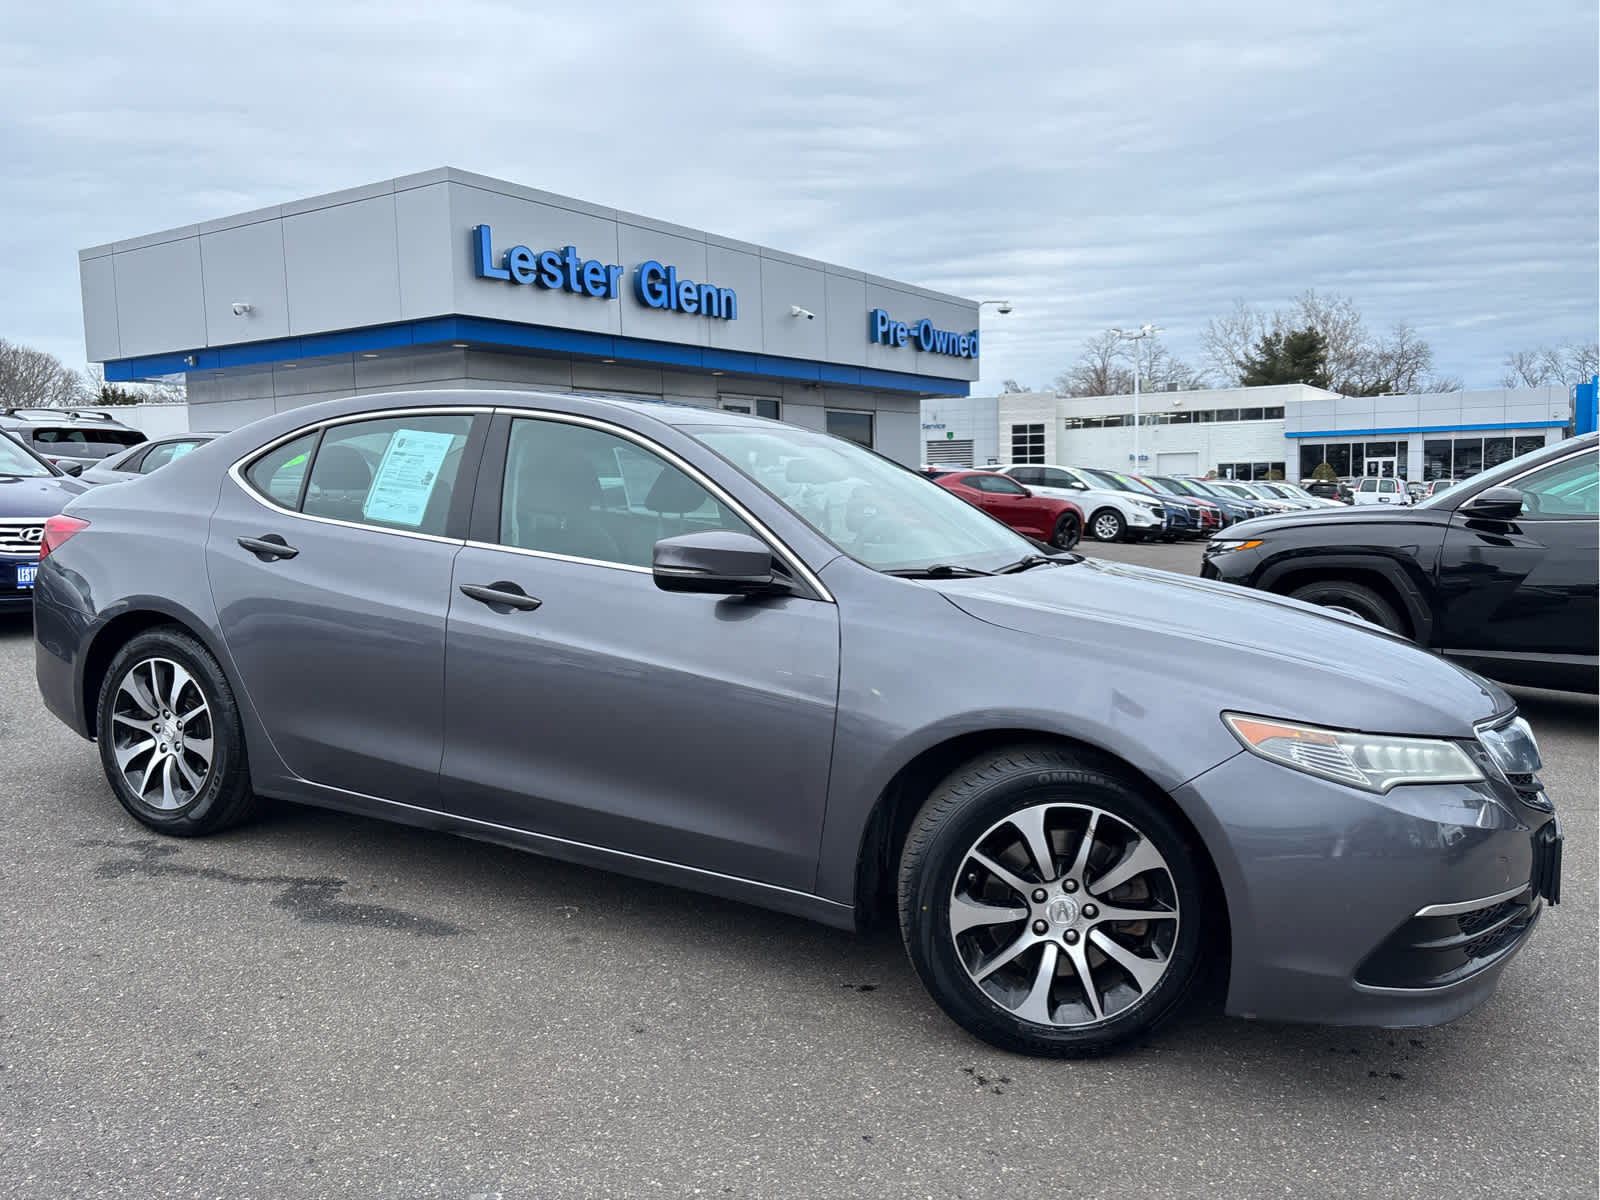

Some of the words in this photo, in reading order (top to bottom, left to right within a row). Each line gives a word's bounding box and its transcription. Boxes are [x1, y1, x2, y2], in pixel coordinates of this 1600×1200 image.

[472, 224, 623, 299] Lester
[633, 260, 737, 320] Glenn
[870, 308, 979, 358] Pre-Owned
